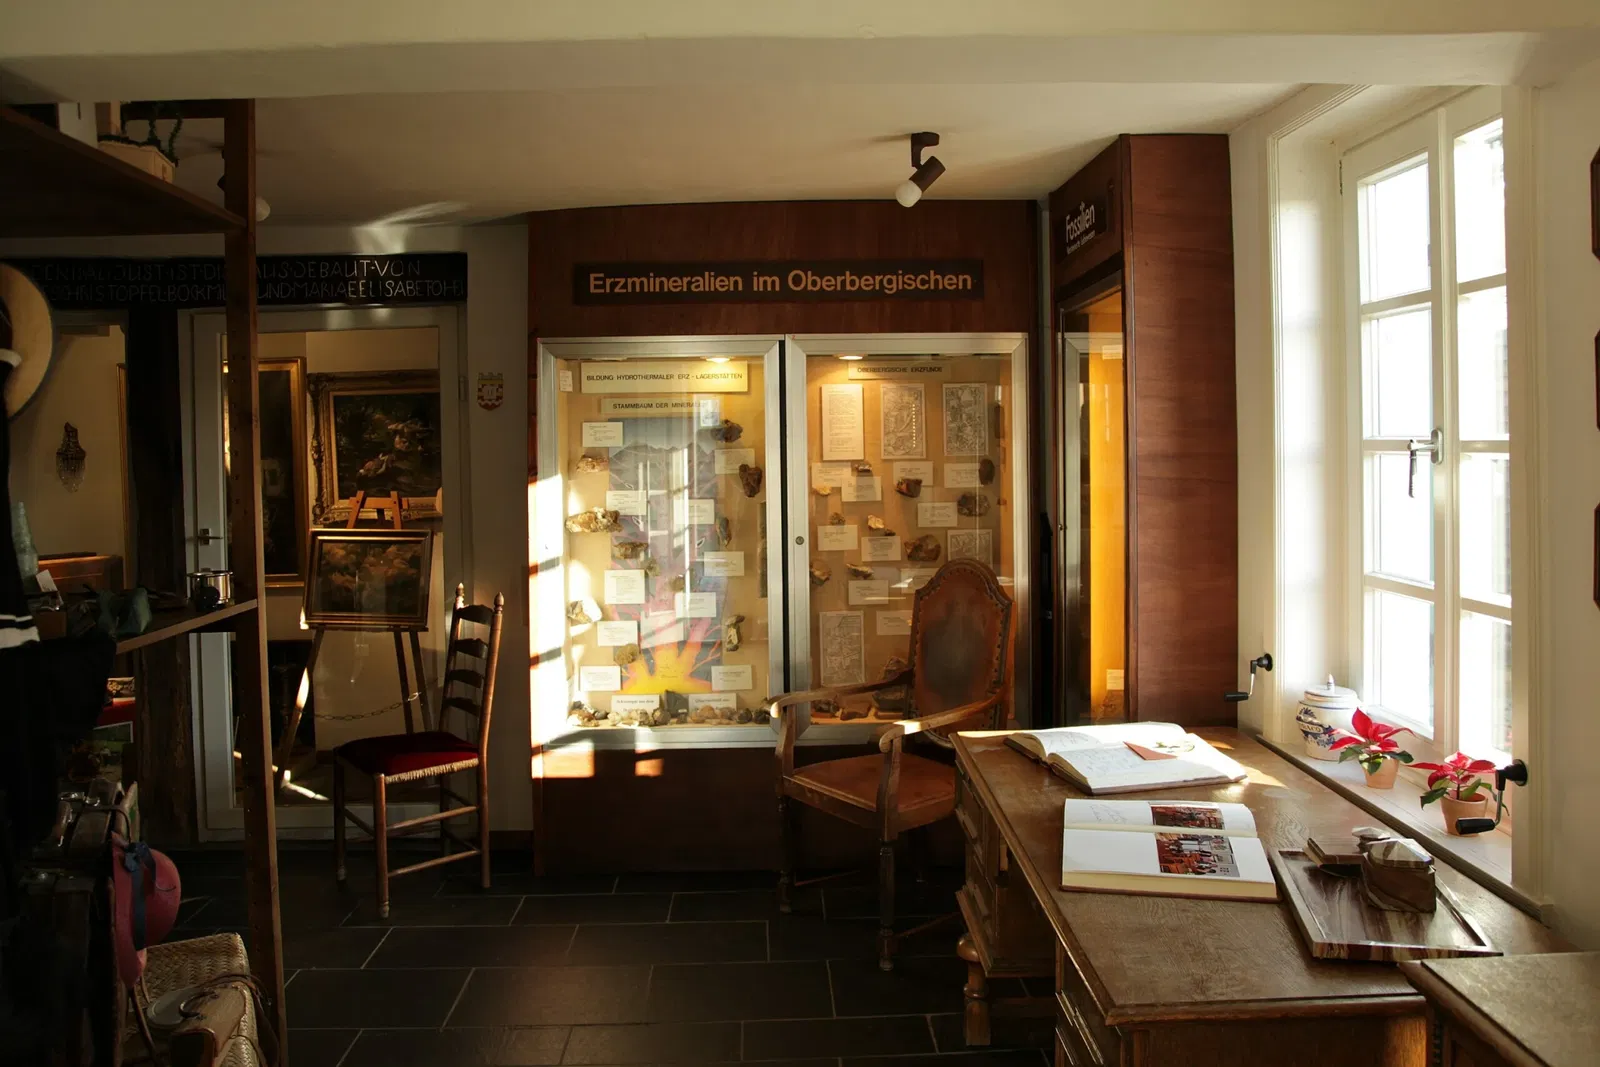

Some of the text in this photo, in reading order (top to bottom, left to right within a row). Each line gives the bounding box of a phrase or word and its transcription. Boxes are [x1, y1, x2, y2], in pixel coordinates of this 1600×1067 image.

[589, 269, 972, 294] Erzmineralien im Oberbergischen
